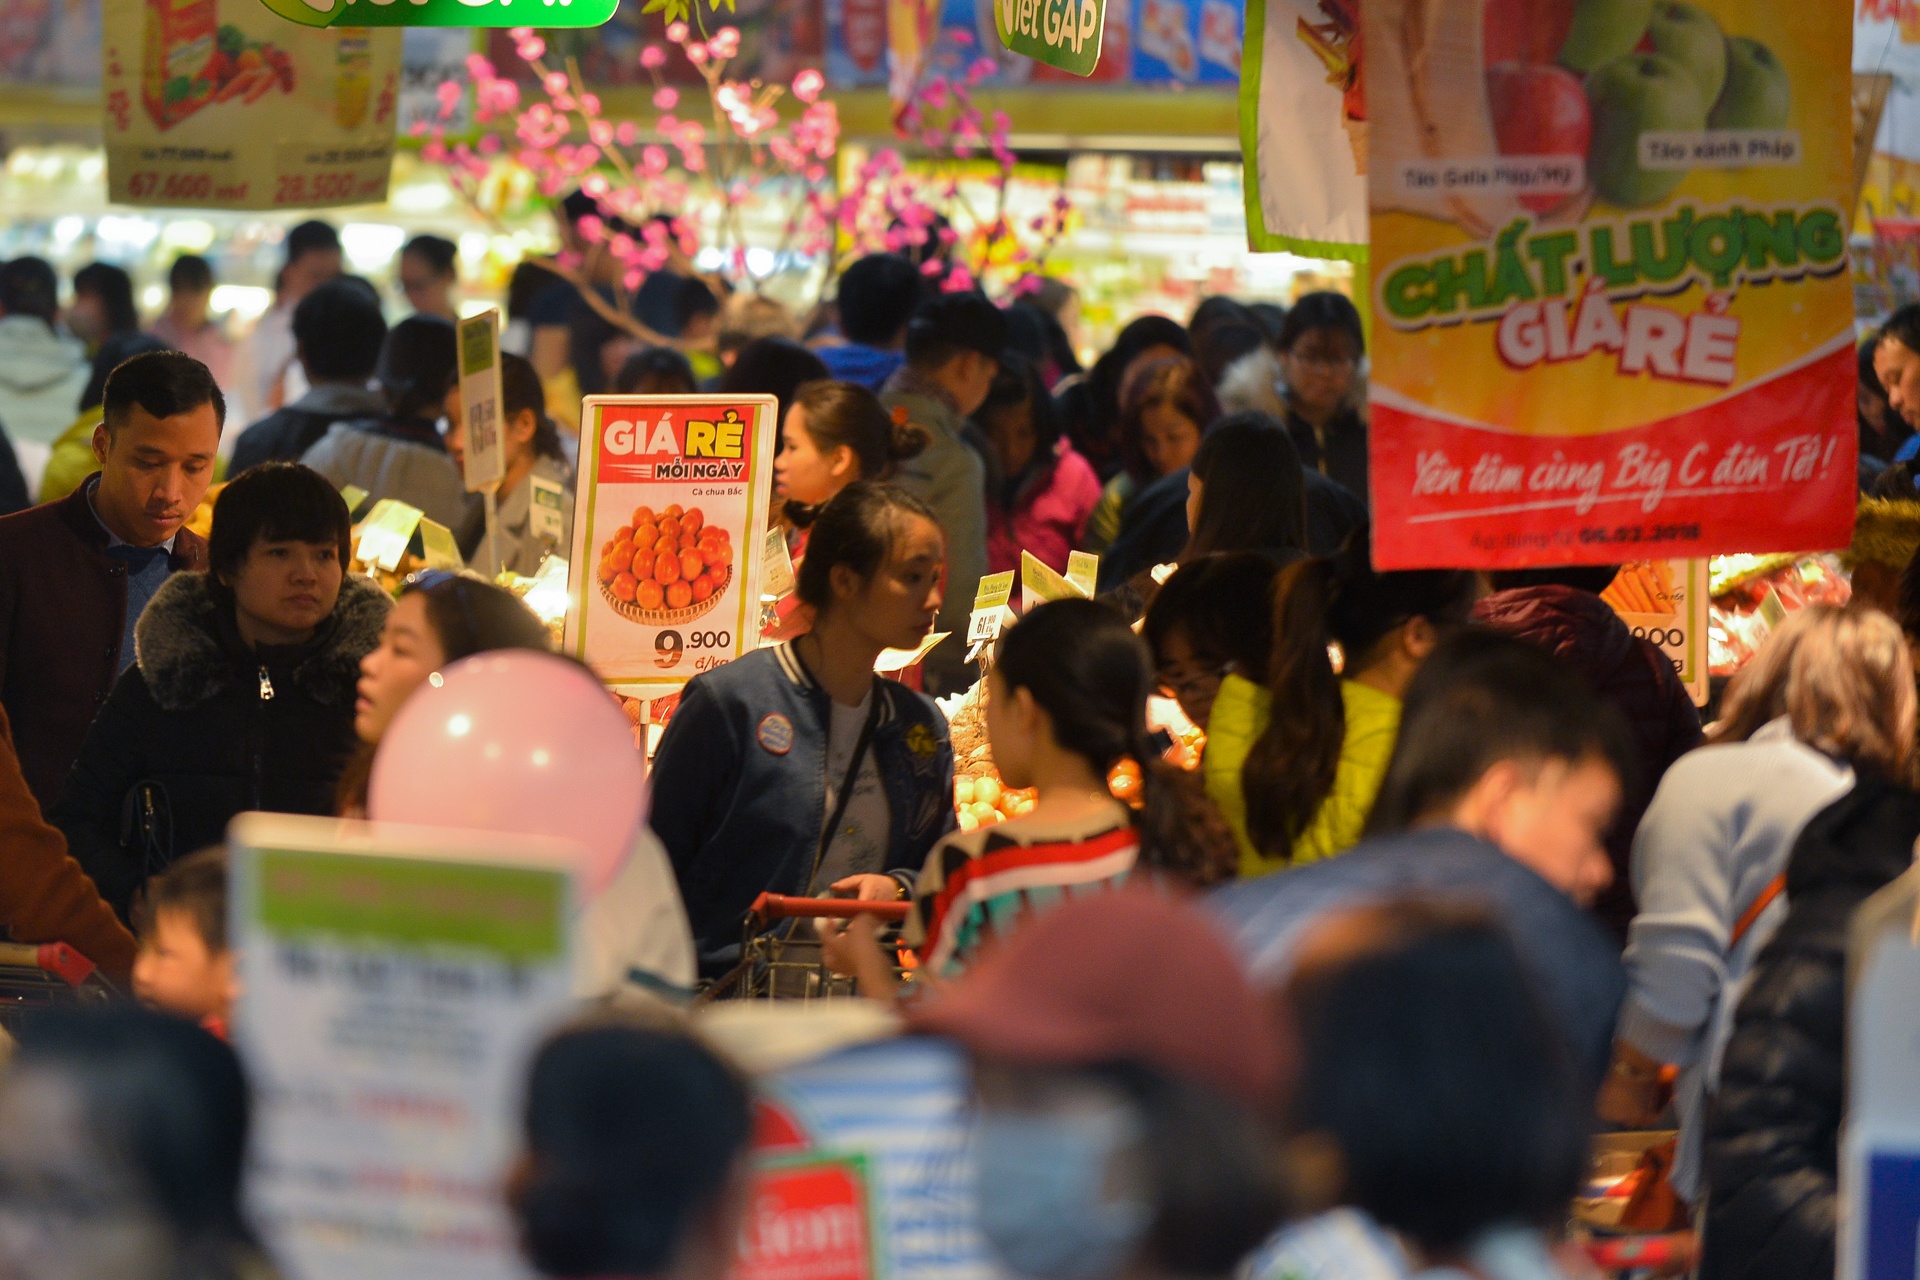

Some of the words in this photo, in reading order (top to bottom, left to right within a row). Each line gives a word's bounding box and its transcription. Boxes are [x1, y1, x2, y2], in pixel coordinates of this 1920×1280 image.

[1384, 217, 1579, 320] CHẤT
[1589, 204, 1845, 290] LƯỢNG
[1499, 276, 1624, 367] GIÁ
[1620, 291, 1740, 387] RẺ
[603, 412, 681, 456] GIÁ
[685, 409, 744, 459] RẺ
[655, 457, 690, 480] MỖI
[692, 459, 745, 480] NGÀY
[692, 488, 703, 496] Cà
[705, 488, 725, 496] chua
[727, 487, 743, 496] Bắc
[1411, 450, 1462, 497] Yên
[1468, 453, 1525, 495] tâm
[1528, 448, 1607, 515] cùng
[1614, 442, 1673, 514] Big
[1678, 443, 1709, 487] C
[1710, 438, 1768, 485] đón
